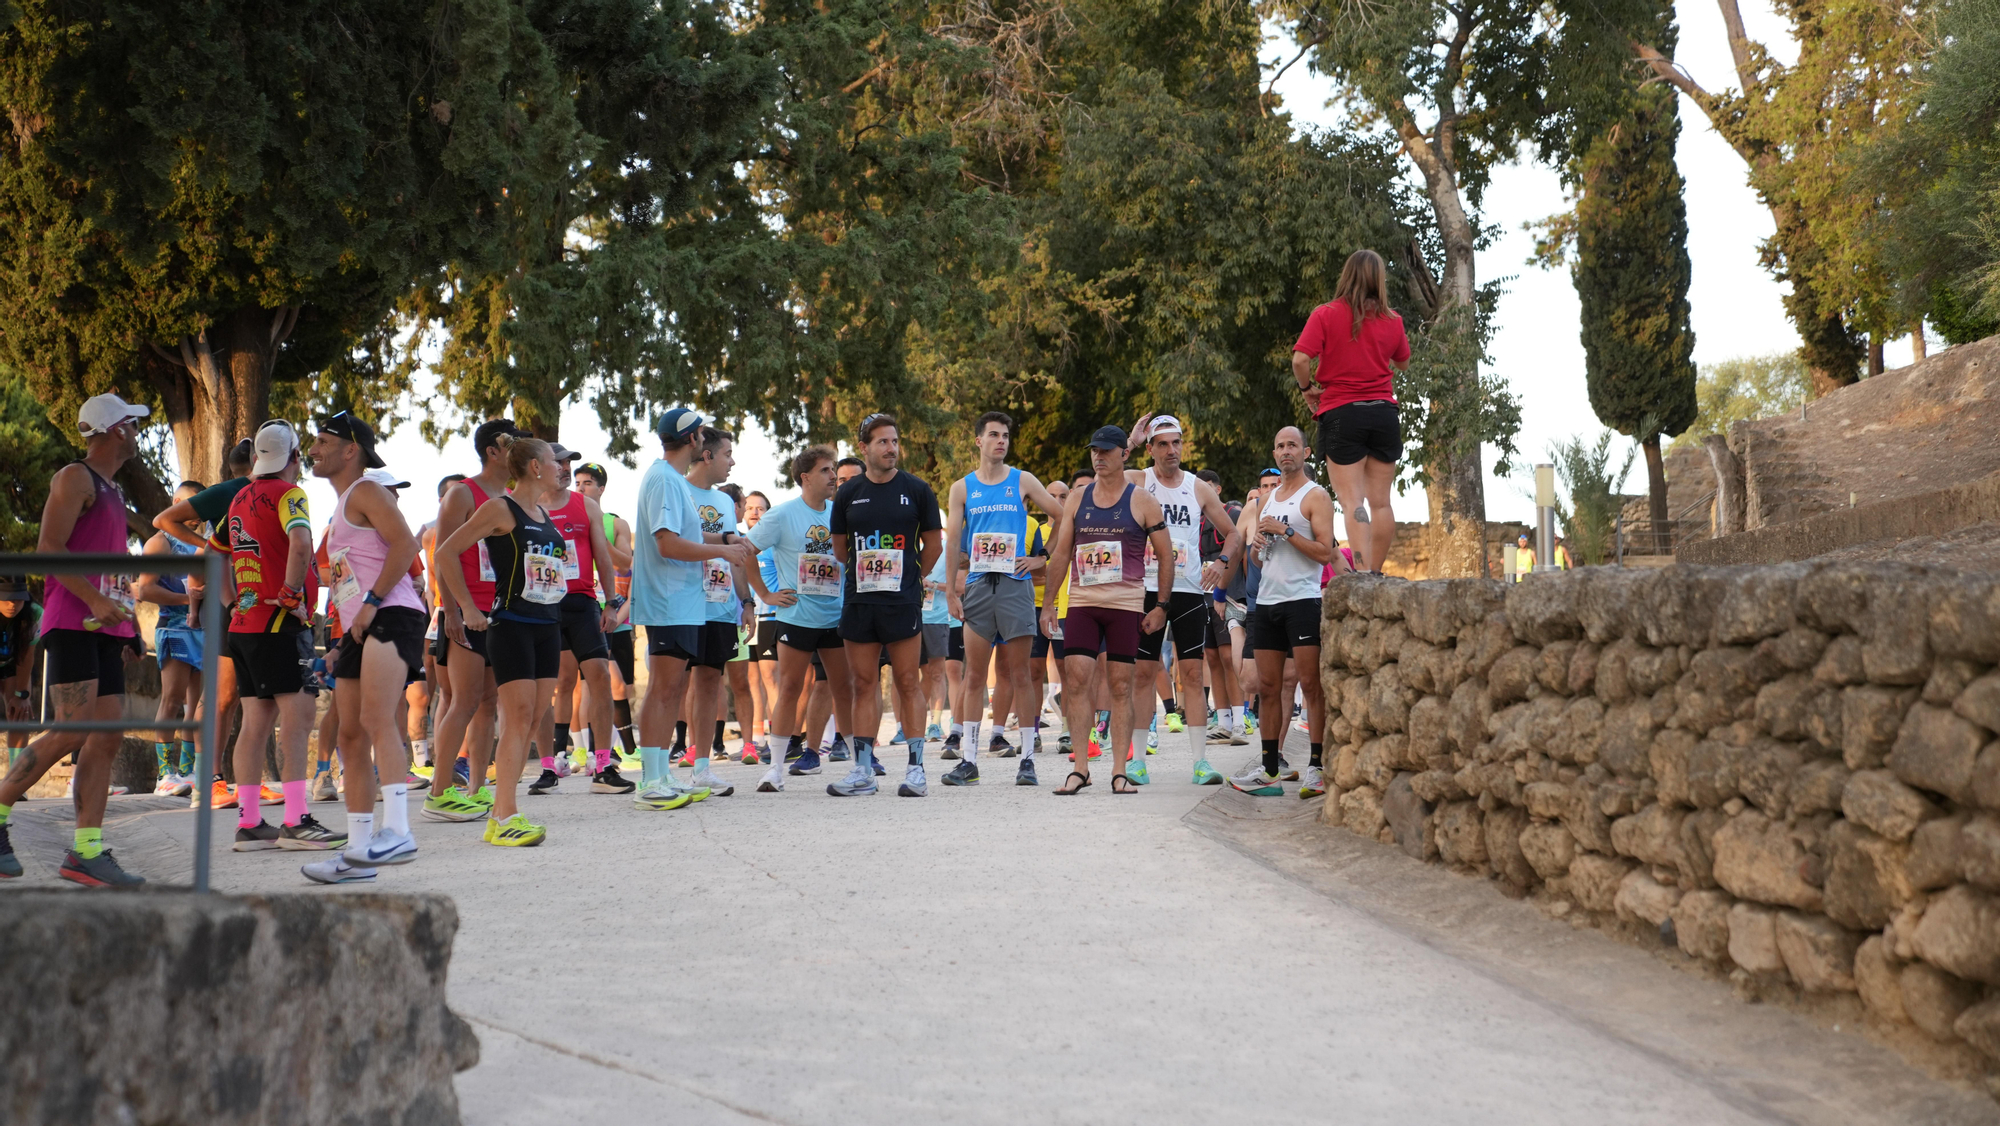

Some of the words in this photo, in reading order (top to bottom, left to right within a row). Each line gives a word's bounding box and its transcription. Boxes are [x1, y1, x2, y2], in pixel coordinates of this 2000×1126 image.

[969, 504, 1018, 515] TROTASIERRA
[1160, 504, 1191, 526] NA
[854, 529, 905, 551] indea
[981, 542, 1007, 555] 349
[865, 559, 893, 573] 484
[1085, 551, 1112, 566] 412
[535, 567, 558, 584] 192
[707, 569, 725, 584] 52
[808, 564, 834, 578] 462
